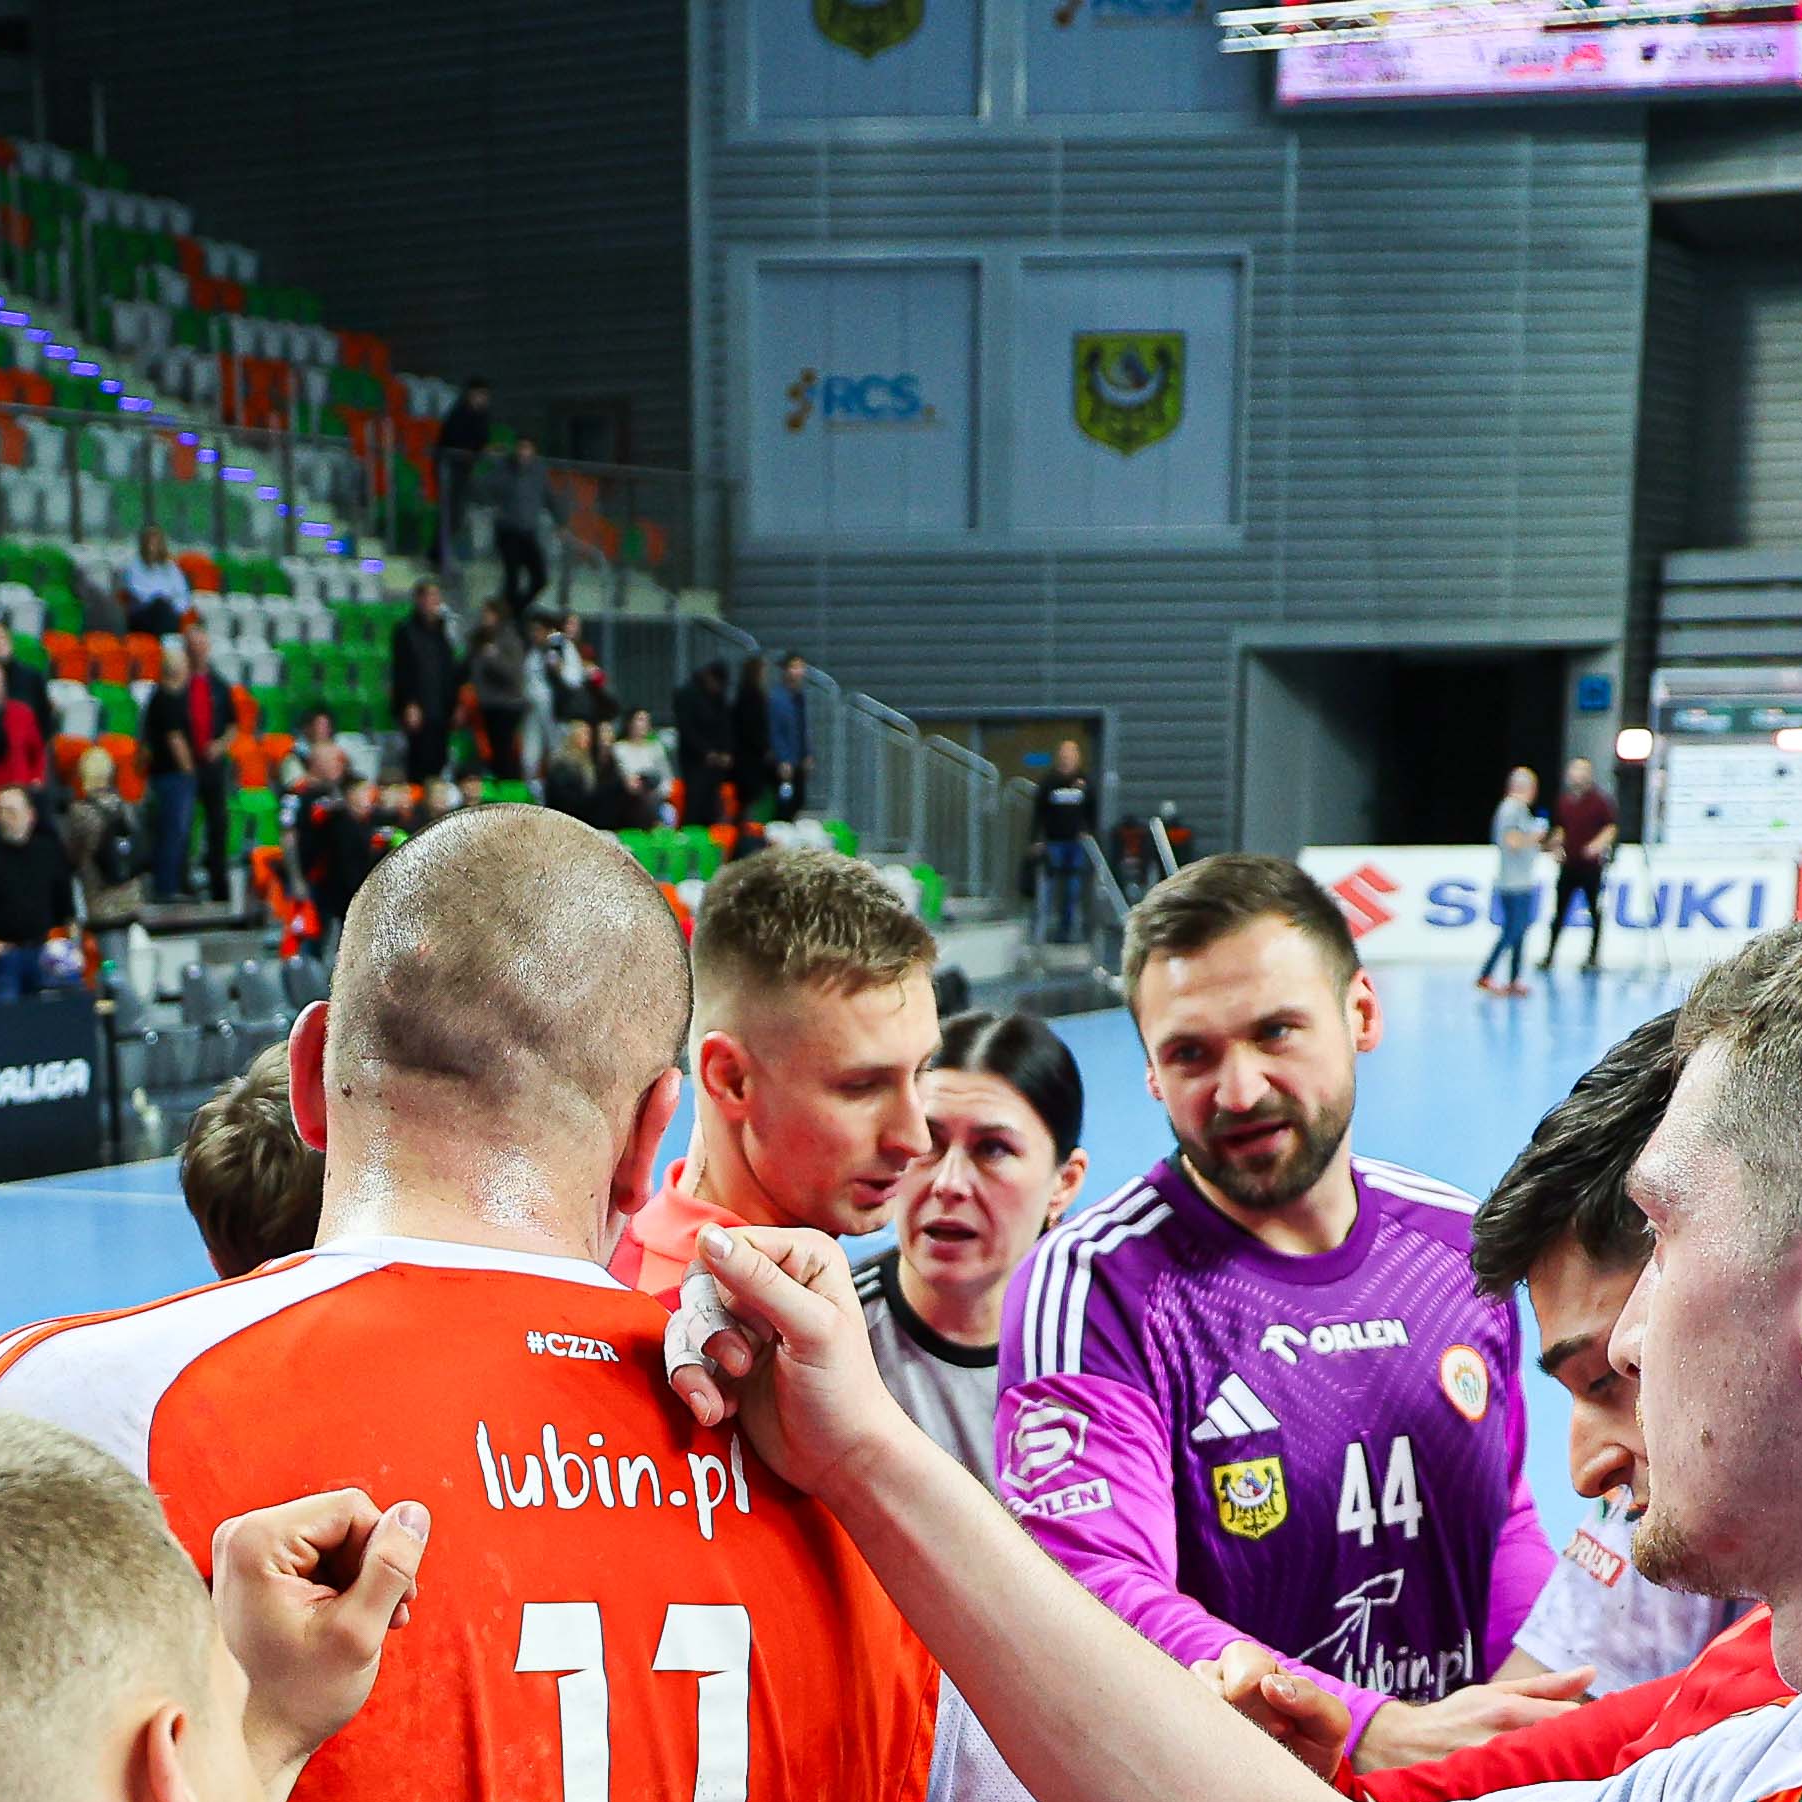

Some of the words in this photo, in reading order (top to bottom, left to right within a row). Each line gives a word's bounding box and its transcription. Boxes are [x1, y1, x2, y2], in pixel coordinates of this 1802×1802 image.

[823, 372, 921, 420] RCS
[525, 1330, 620, 1362] #CZZR
[1310, 1318, 1410, 1355] ORLEN
[475, 1420, 751, 1542] lubin.pl
[1336, 1435, 1424, 1548] 44
